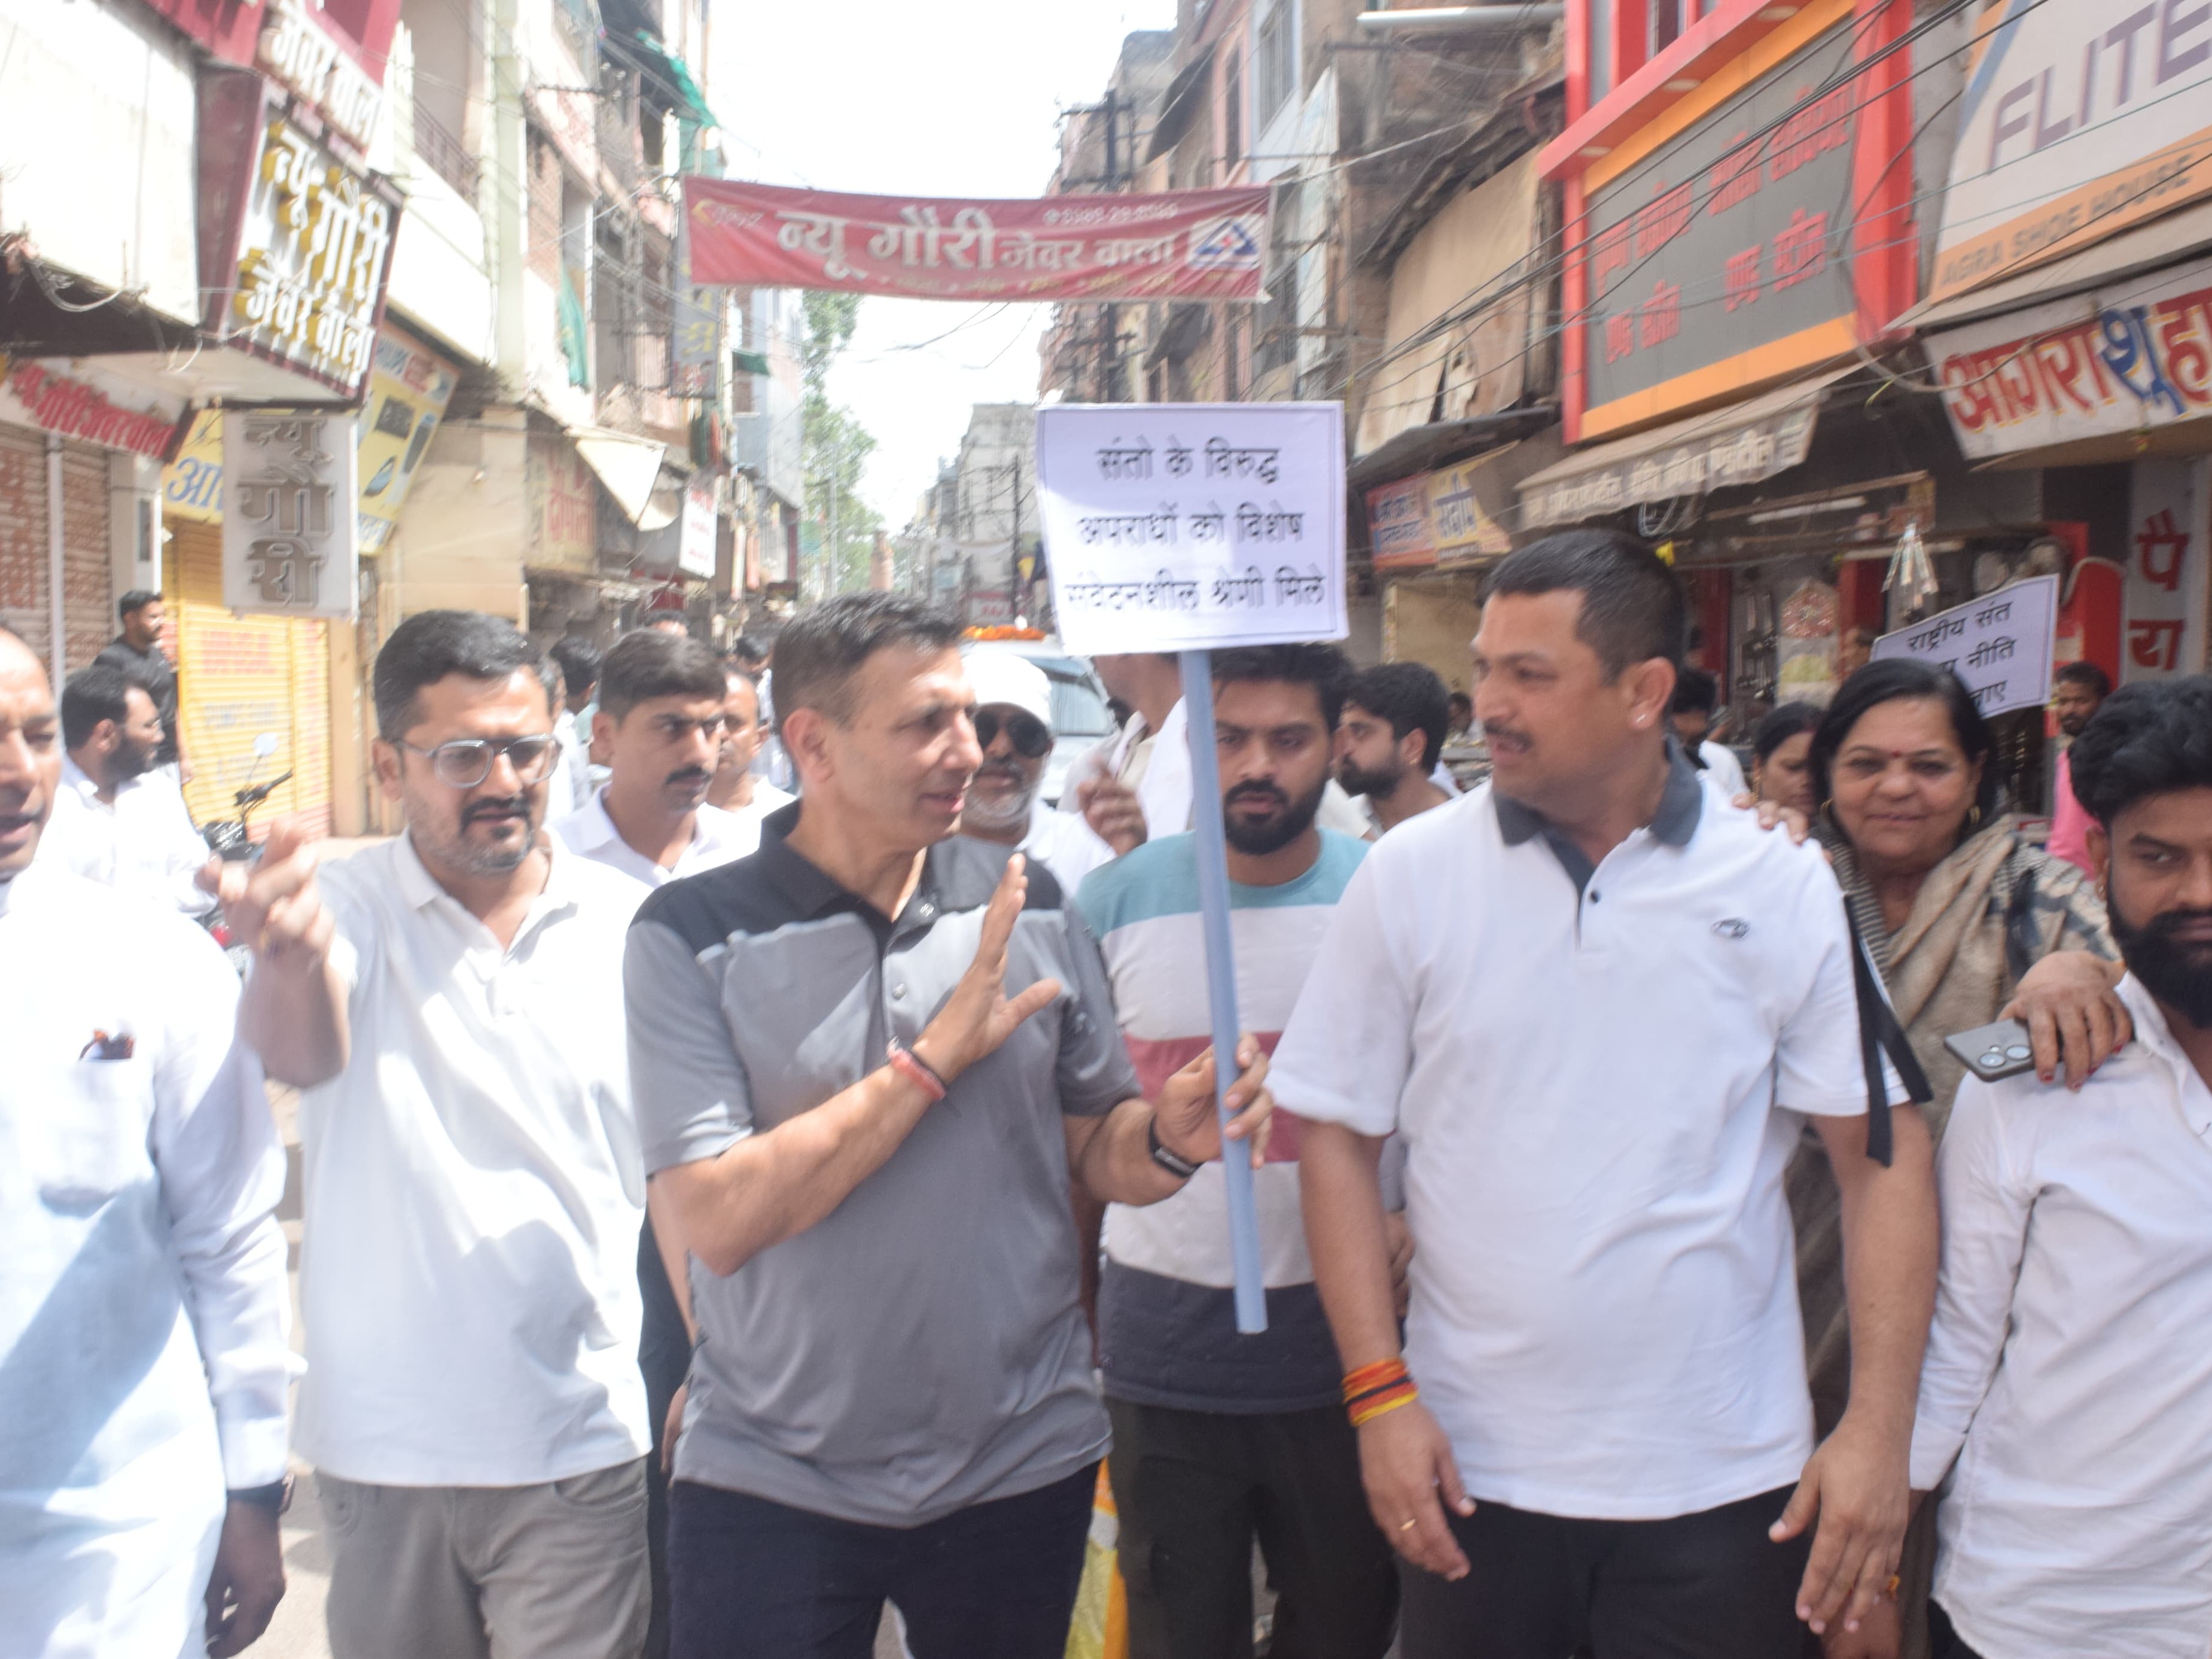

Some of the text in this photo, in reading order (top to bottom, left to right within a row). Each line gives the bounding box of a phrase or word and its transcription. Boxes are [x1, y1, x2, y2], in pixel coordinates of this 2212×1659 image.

[1986, 0, 2212, 177] FLITE
[775, 210, 868, 279] न्यू
[863, 205, 1000, 270] गौरी
[1000, 231, 1084, 270] जेवर
[1092, 234, 1181, 267] वाला
[1943, 320, 2113, 430] आगरा
[1164, 434, 1195, 479] के
[1189, 500, 1224, 543] को
[1236, 501, 1306, 543] विशेष
[1906, 600, 2013, 653] राष्ट्रीय संत
[1968, 635, 2016, 669] नीति
